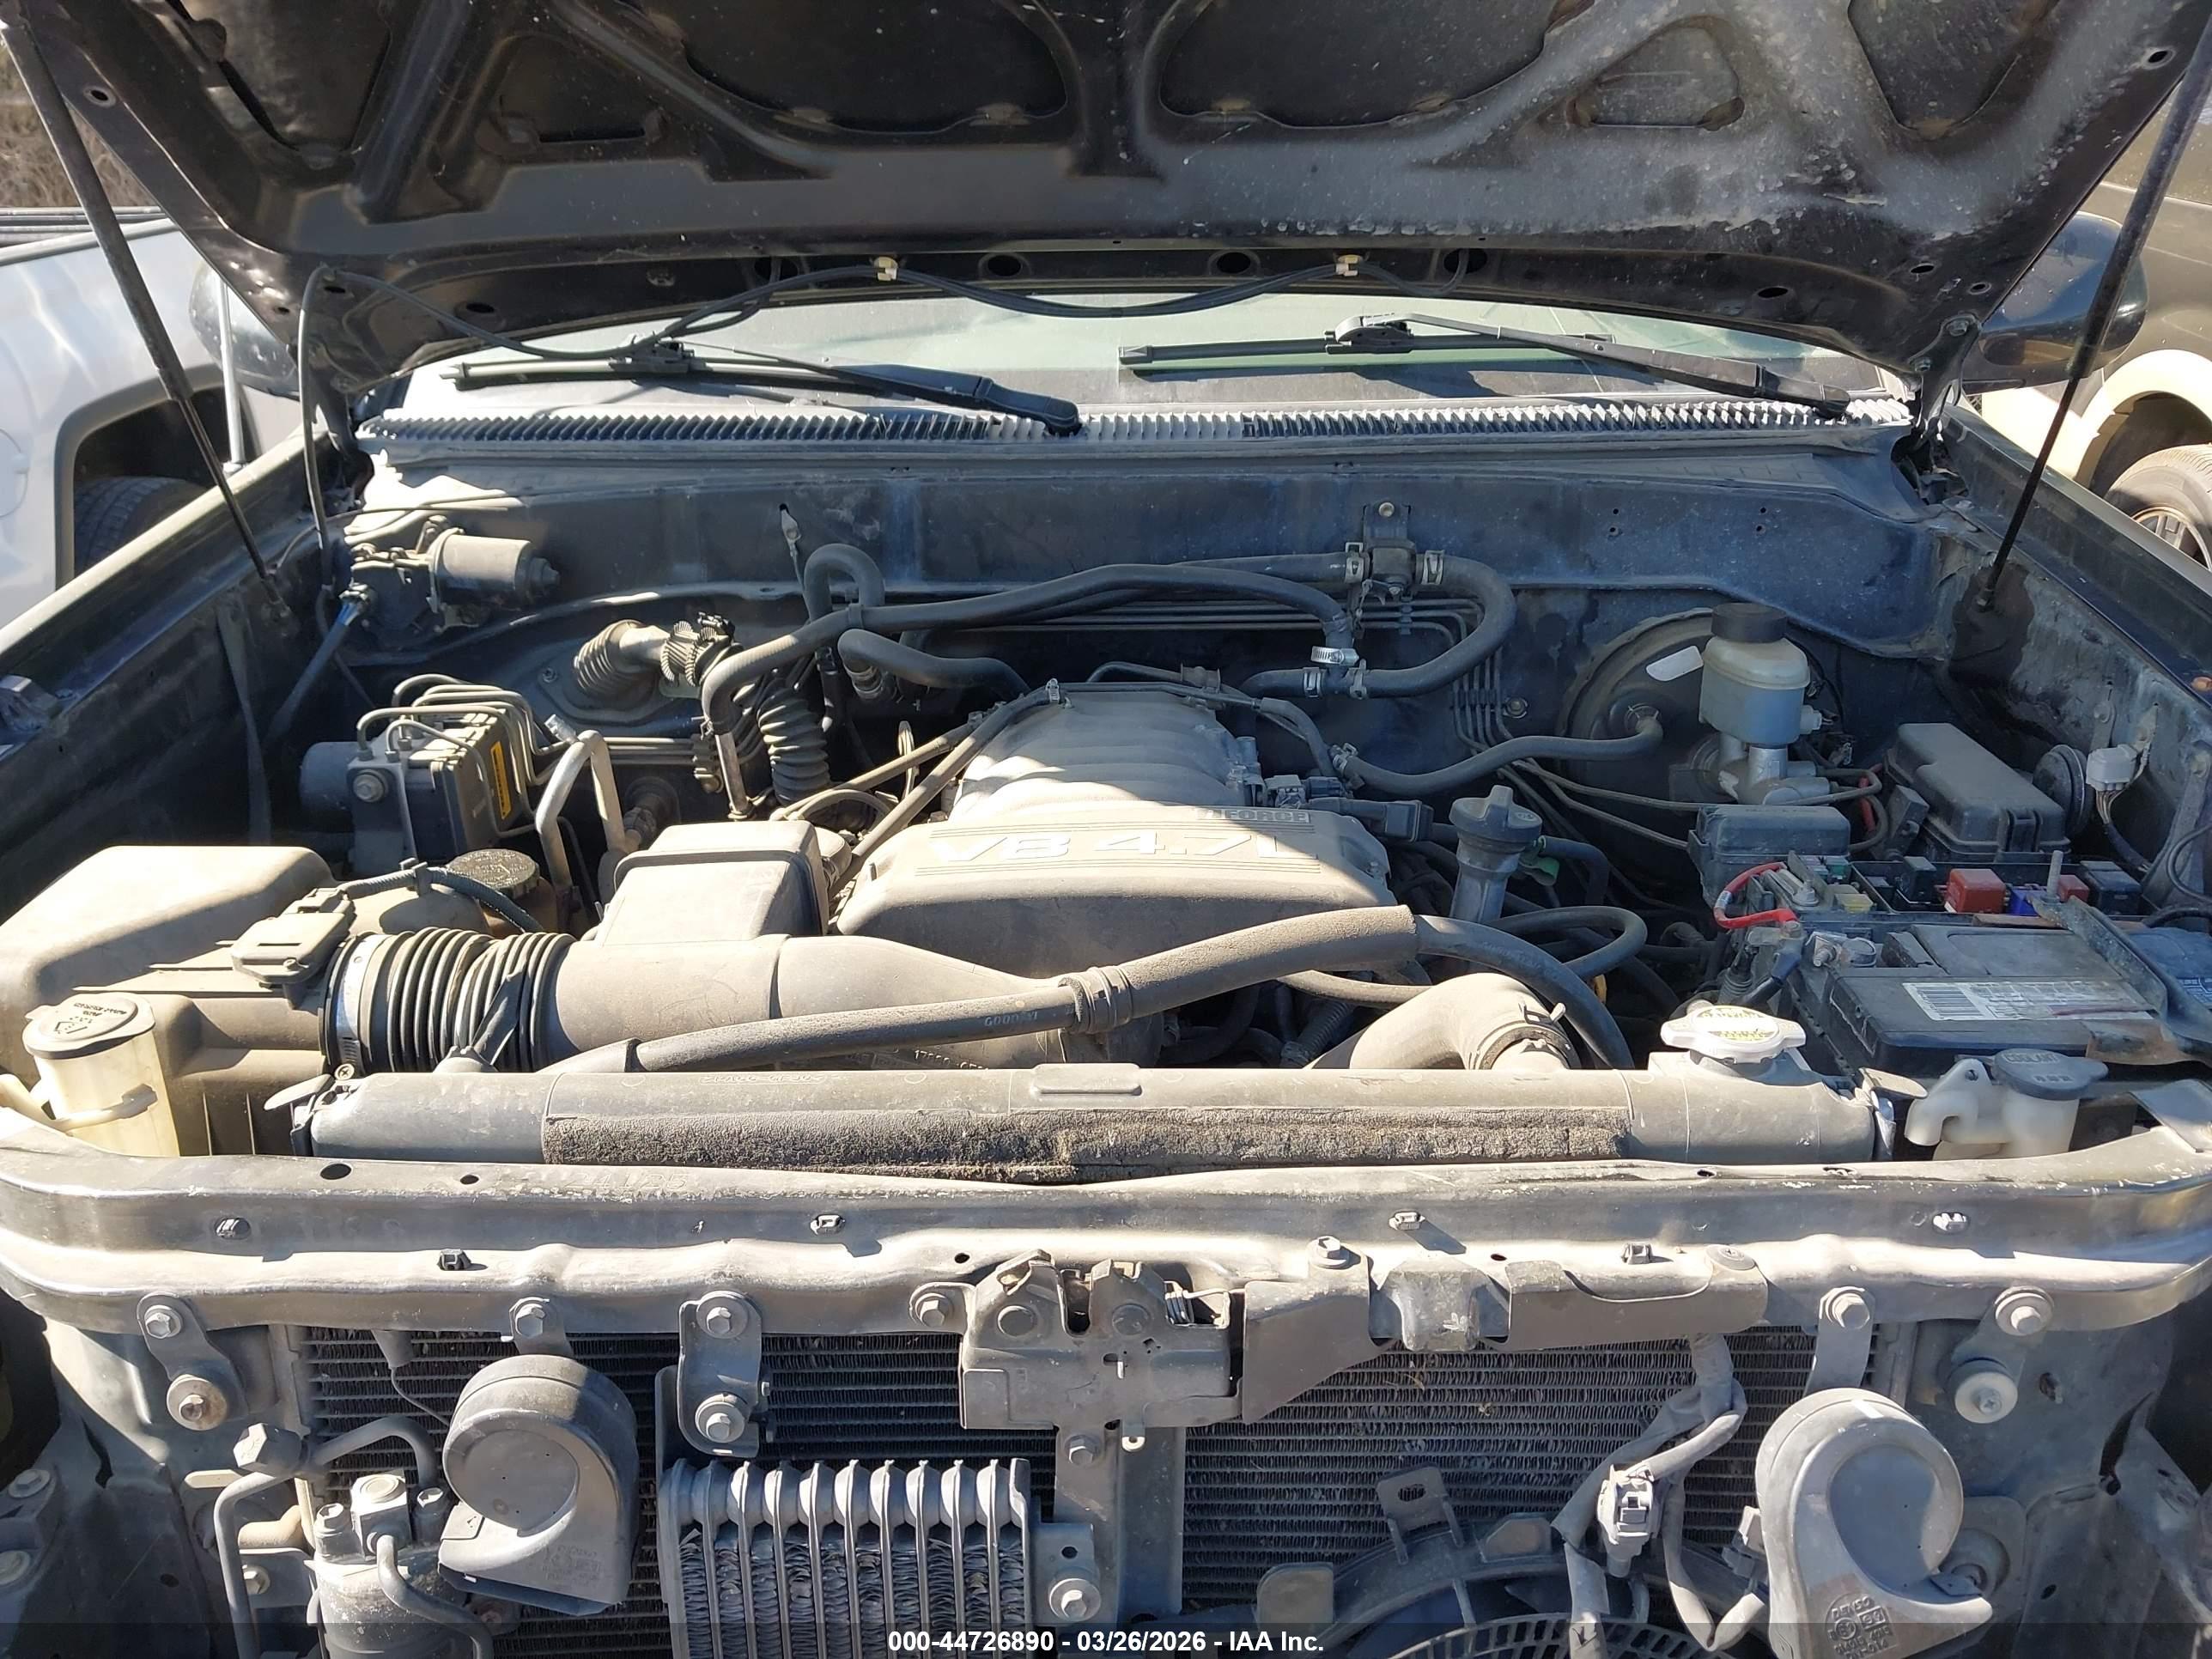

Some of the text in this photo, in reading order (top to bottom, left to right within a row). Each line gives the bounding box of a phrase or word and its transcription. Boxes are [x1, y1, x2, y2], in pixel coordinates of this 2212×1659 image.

[930, 831, 1319, 862] V8 4.7L
[1831, 1595, 1870, 1620] DENSO
